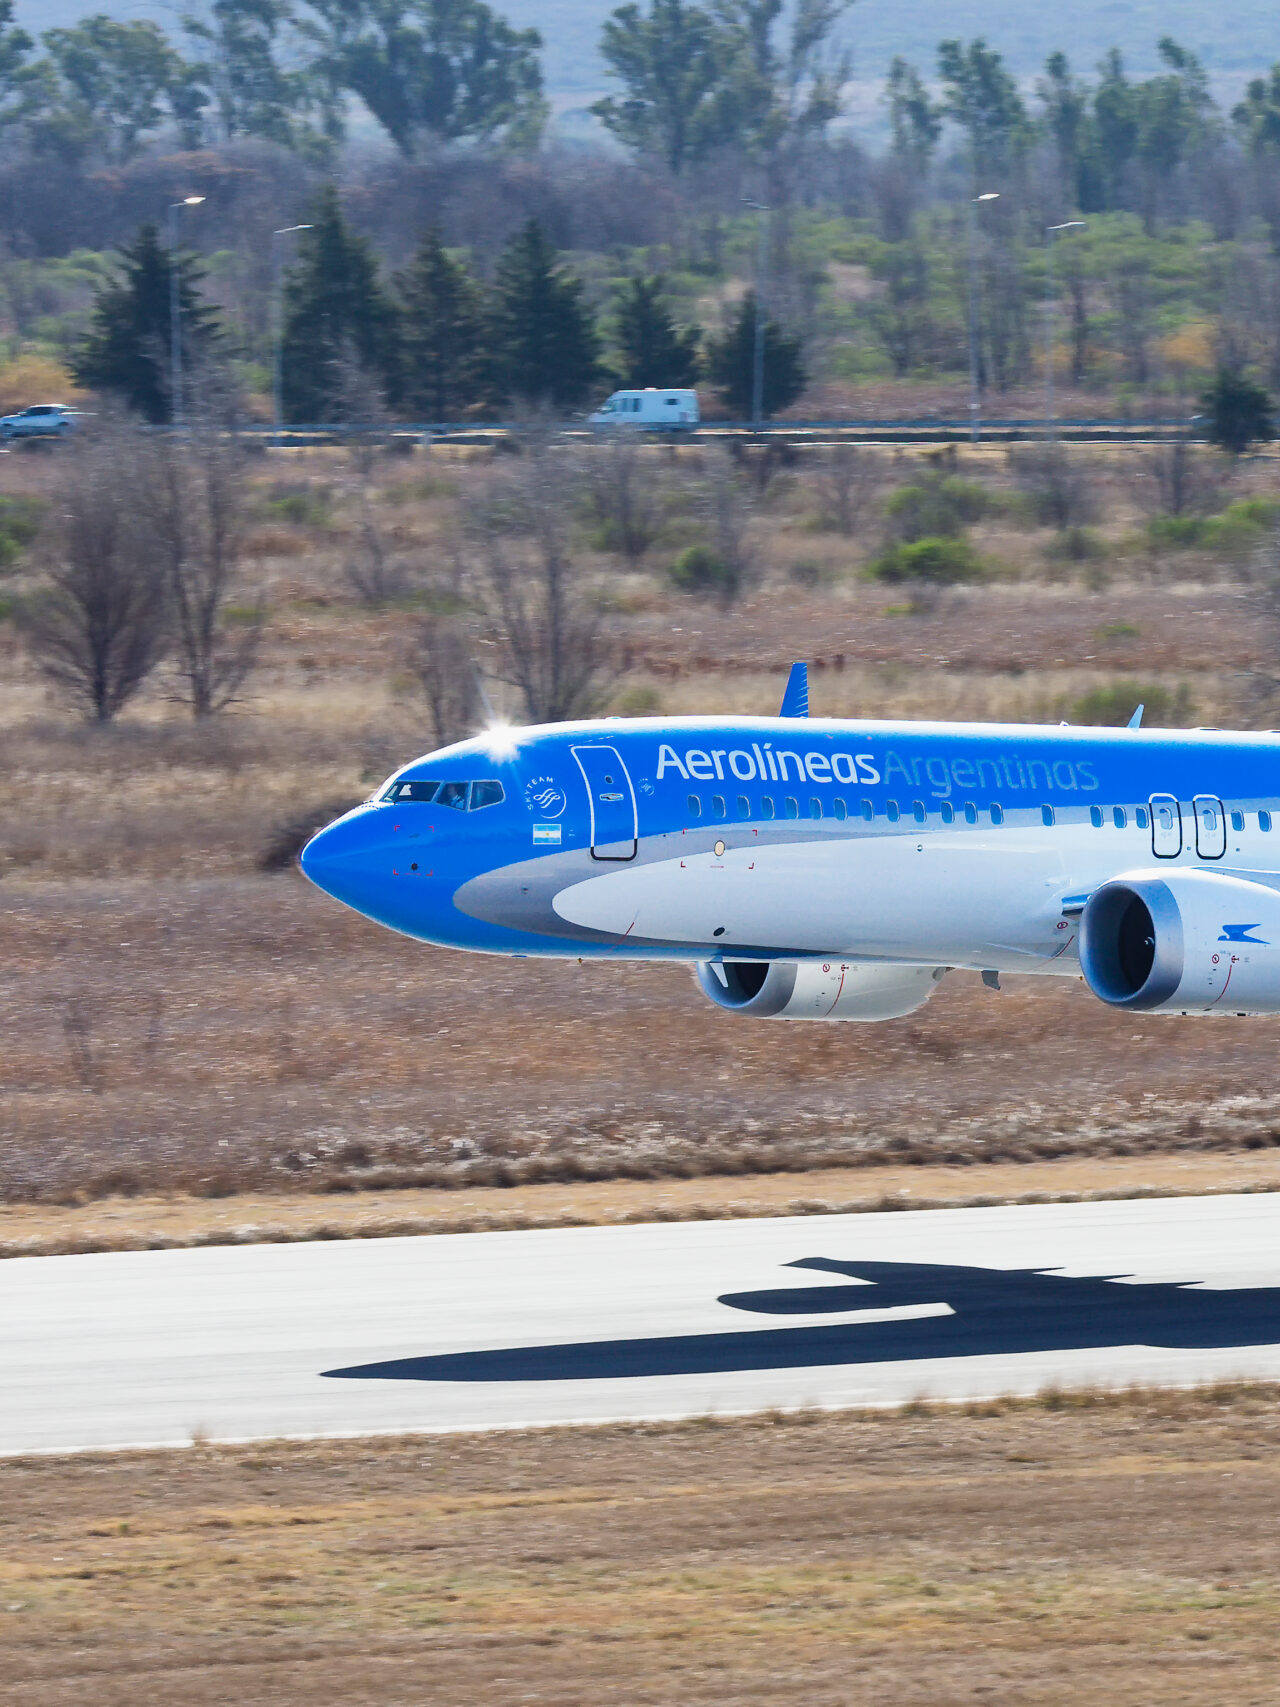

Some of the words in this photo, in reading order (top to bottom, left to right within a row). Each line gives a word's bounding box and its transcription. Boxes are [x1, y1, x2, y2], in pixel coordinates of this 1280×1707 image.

[656, 743, 881, 785] Aerolíneas
[883, 750, 1099, 798] Argentinas
[524, 776, 554, 811] SKYTEAM
